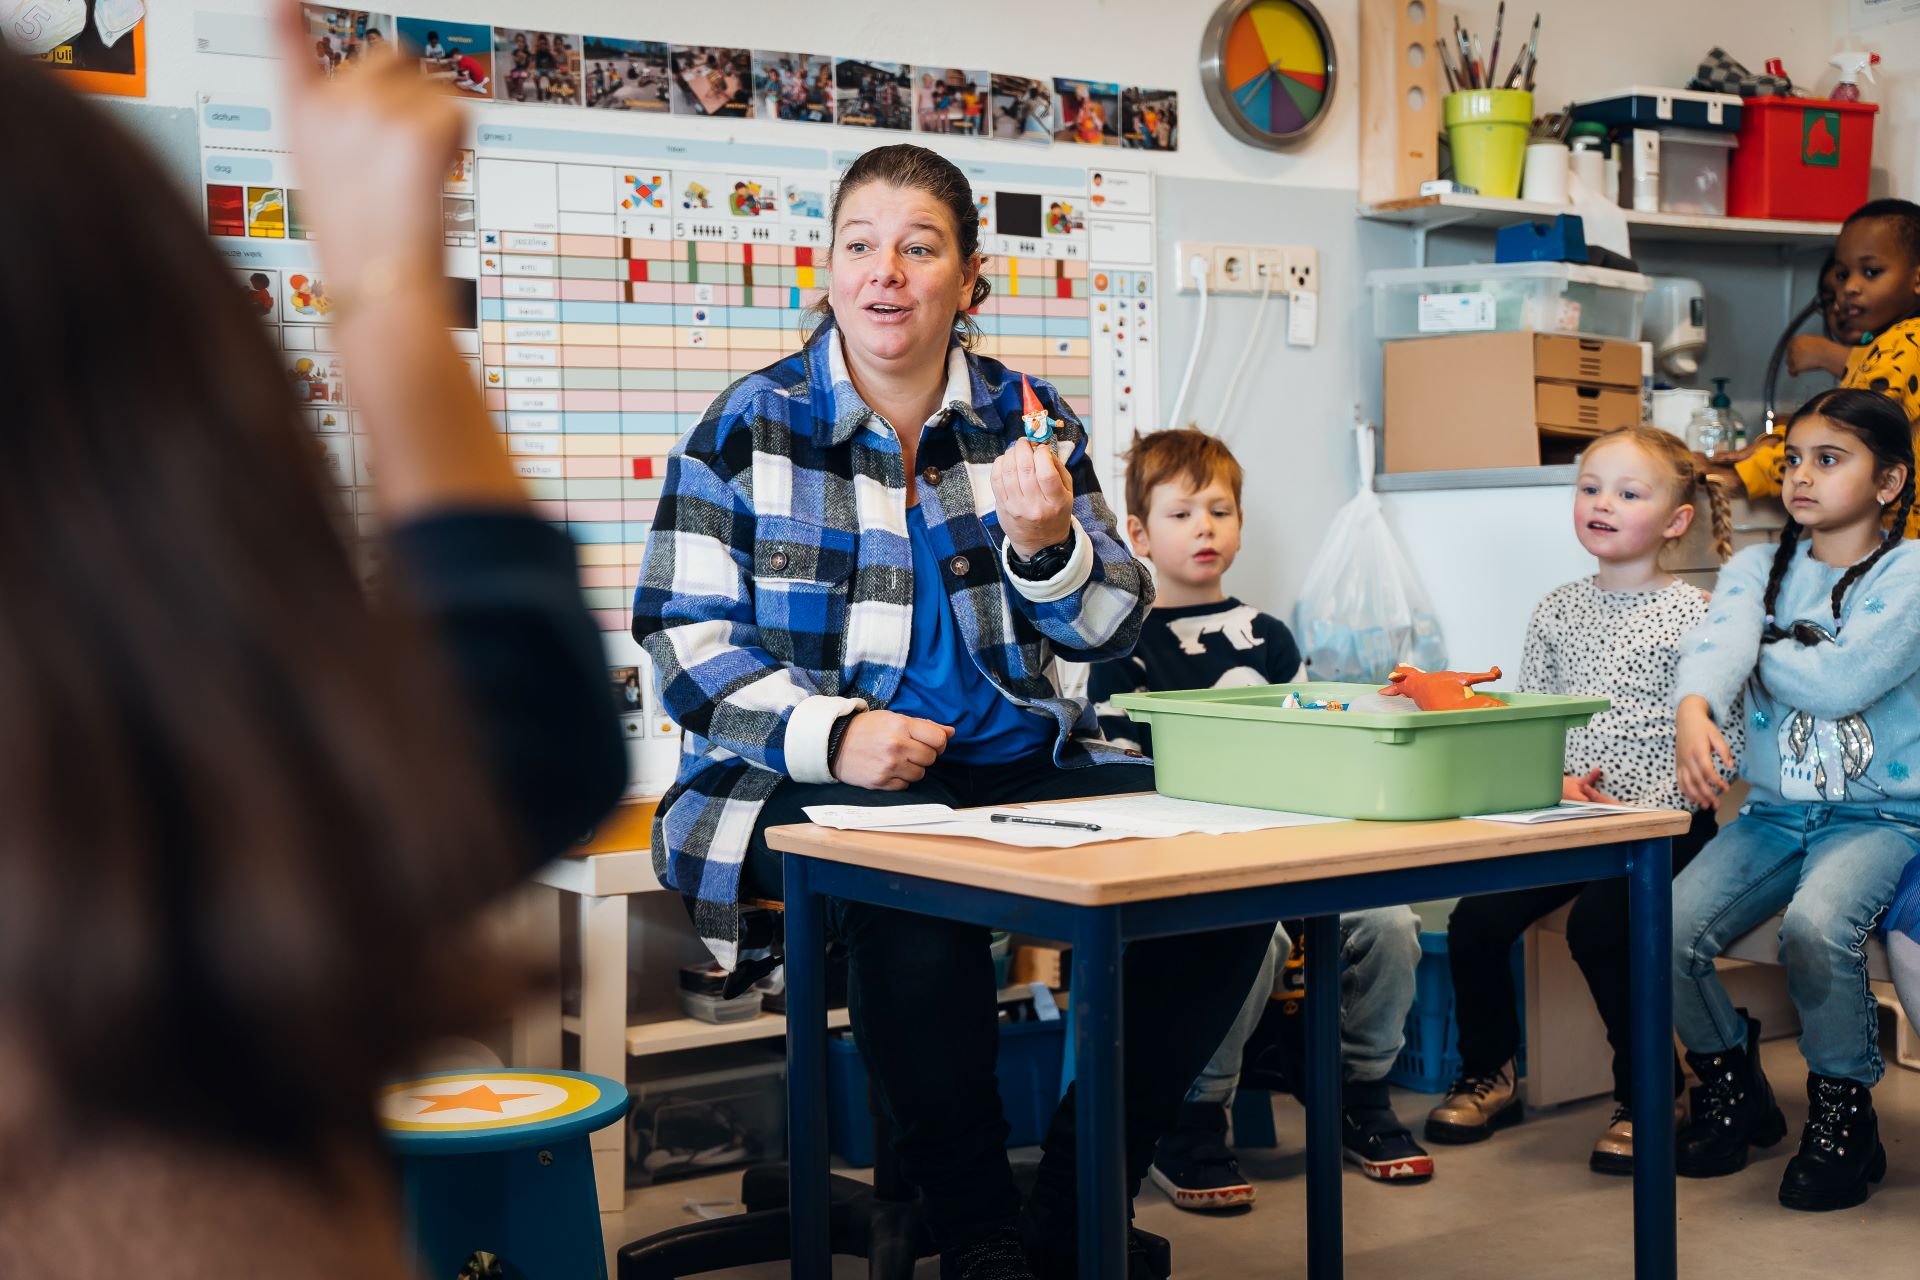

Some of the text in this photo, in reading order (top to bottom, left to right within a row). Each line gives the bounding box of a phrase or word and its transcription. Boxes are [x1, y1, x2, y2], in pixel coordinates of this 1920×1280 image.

[14, 5, 51, 41] 5
[211, 112, 241, 122] datum
[213, 163, 232, 174] dag
[621, 220, 627, 234] 1
[676, 224, 686, 237] 5
[731, 226, 739, 239] 3
[789, 229, 797, 241] 2
[1046, 242, 1053, 255] 2
